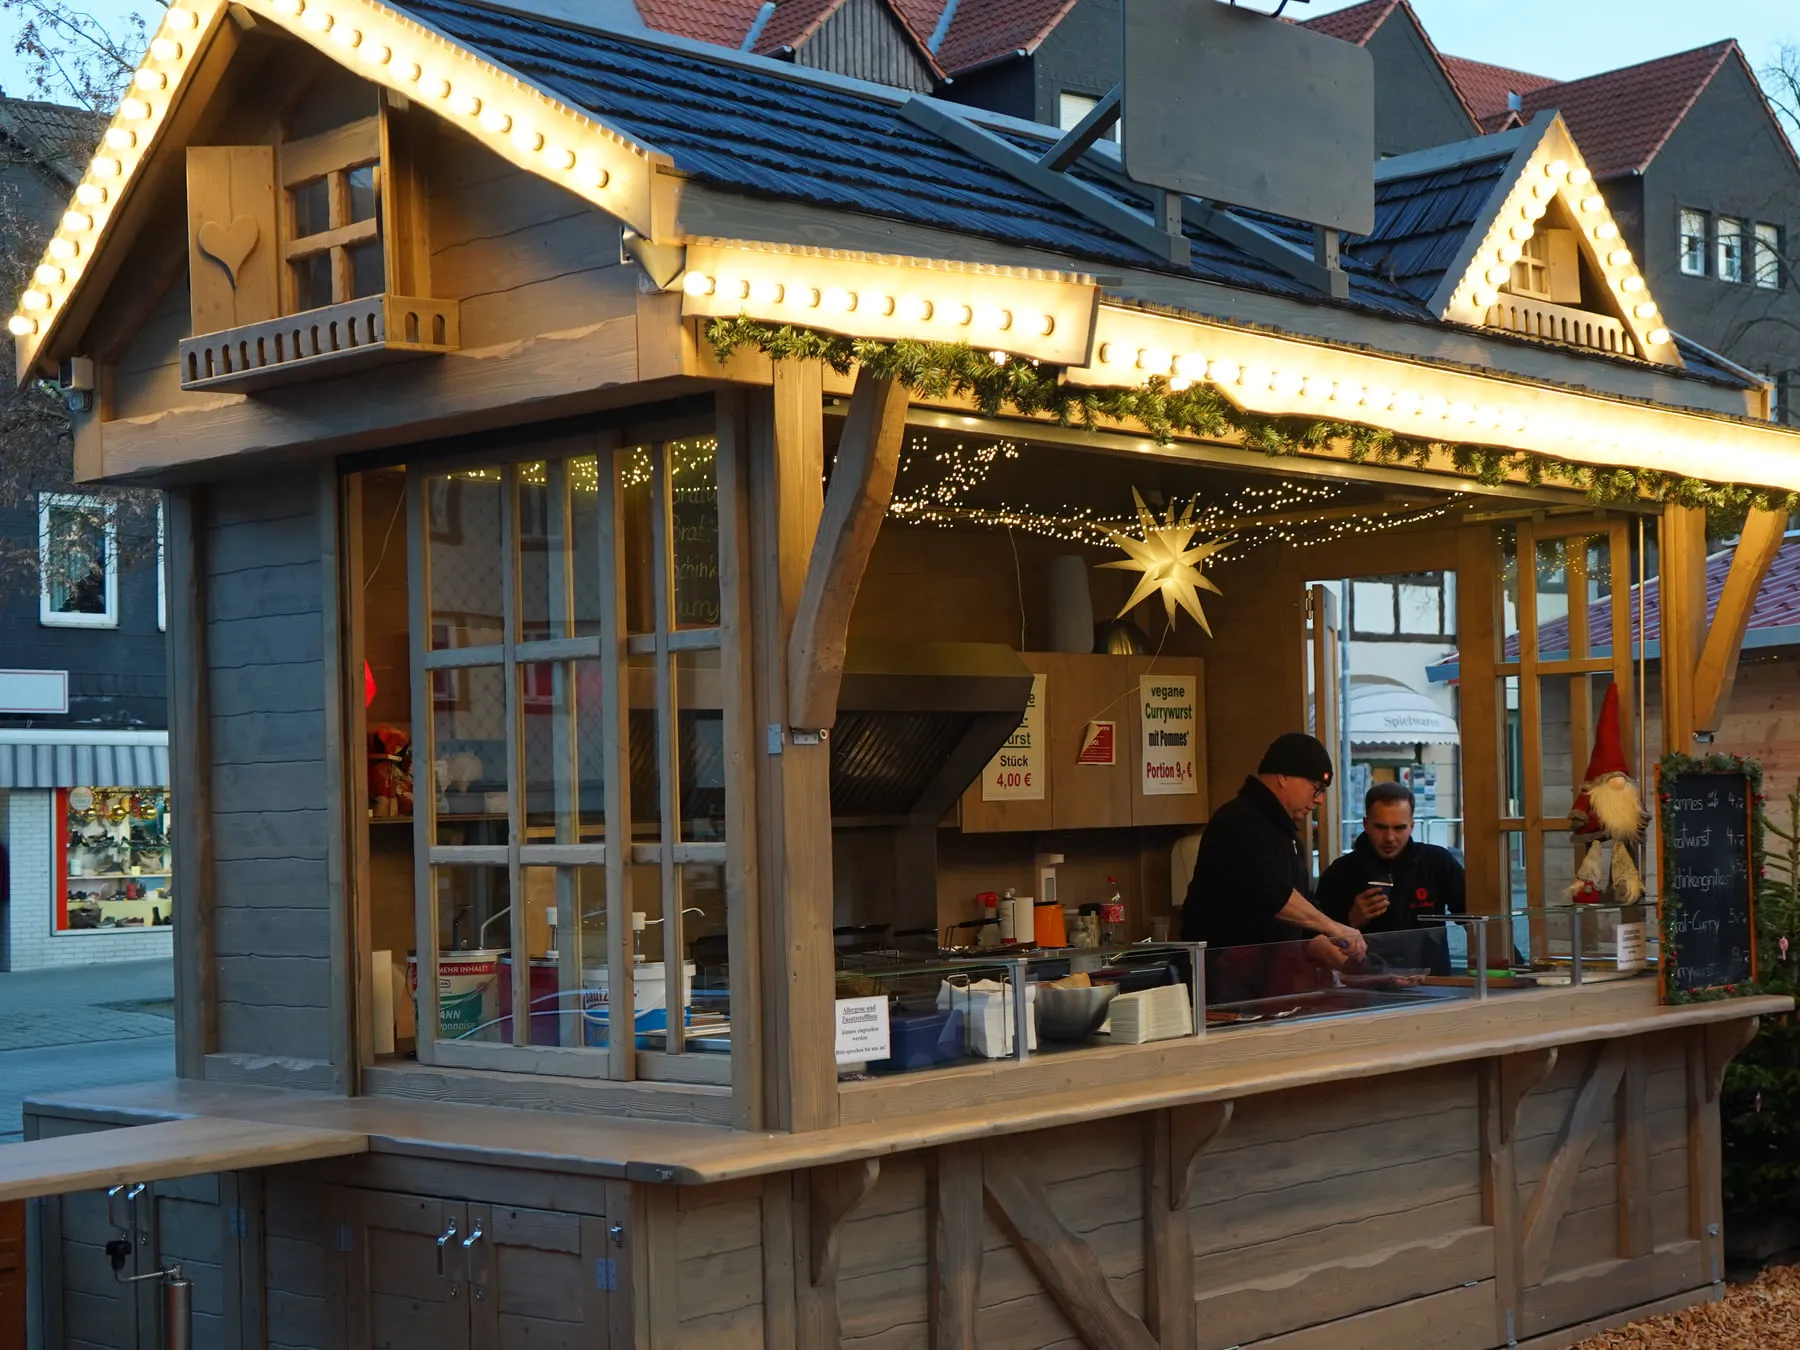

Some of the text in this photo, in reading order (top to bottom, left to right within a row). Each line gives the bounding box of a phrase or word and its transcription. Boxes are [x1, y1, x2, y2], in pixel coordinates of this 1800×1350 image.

[679, 600, 719, 622] urry
[1151, 686, 1185, 700] vegane
[1145, 702, 1192, 724] Currywurst
[1007, 732, 1031, 745] urst
[1148, 730, 1159, 746] mit
[1000, 754, 1029, 767] Stück
[1146, 762, 1174, 778] Portion
[996, 773, 1021, 789] 4,00
